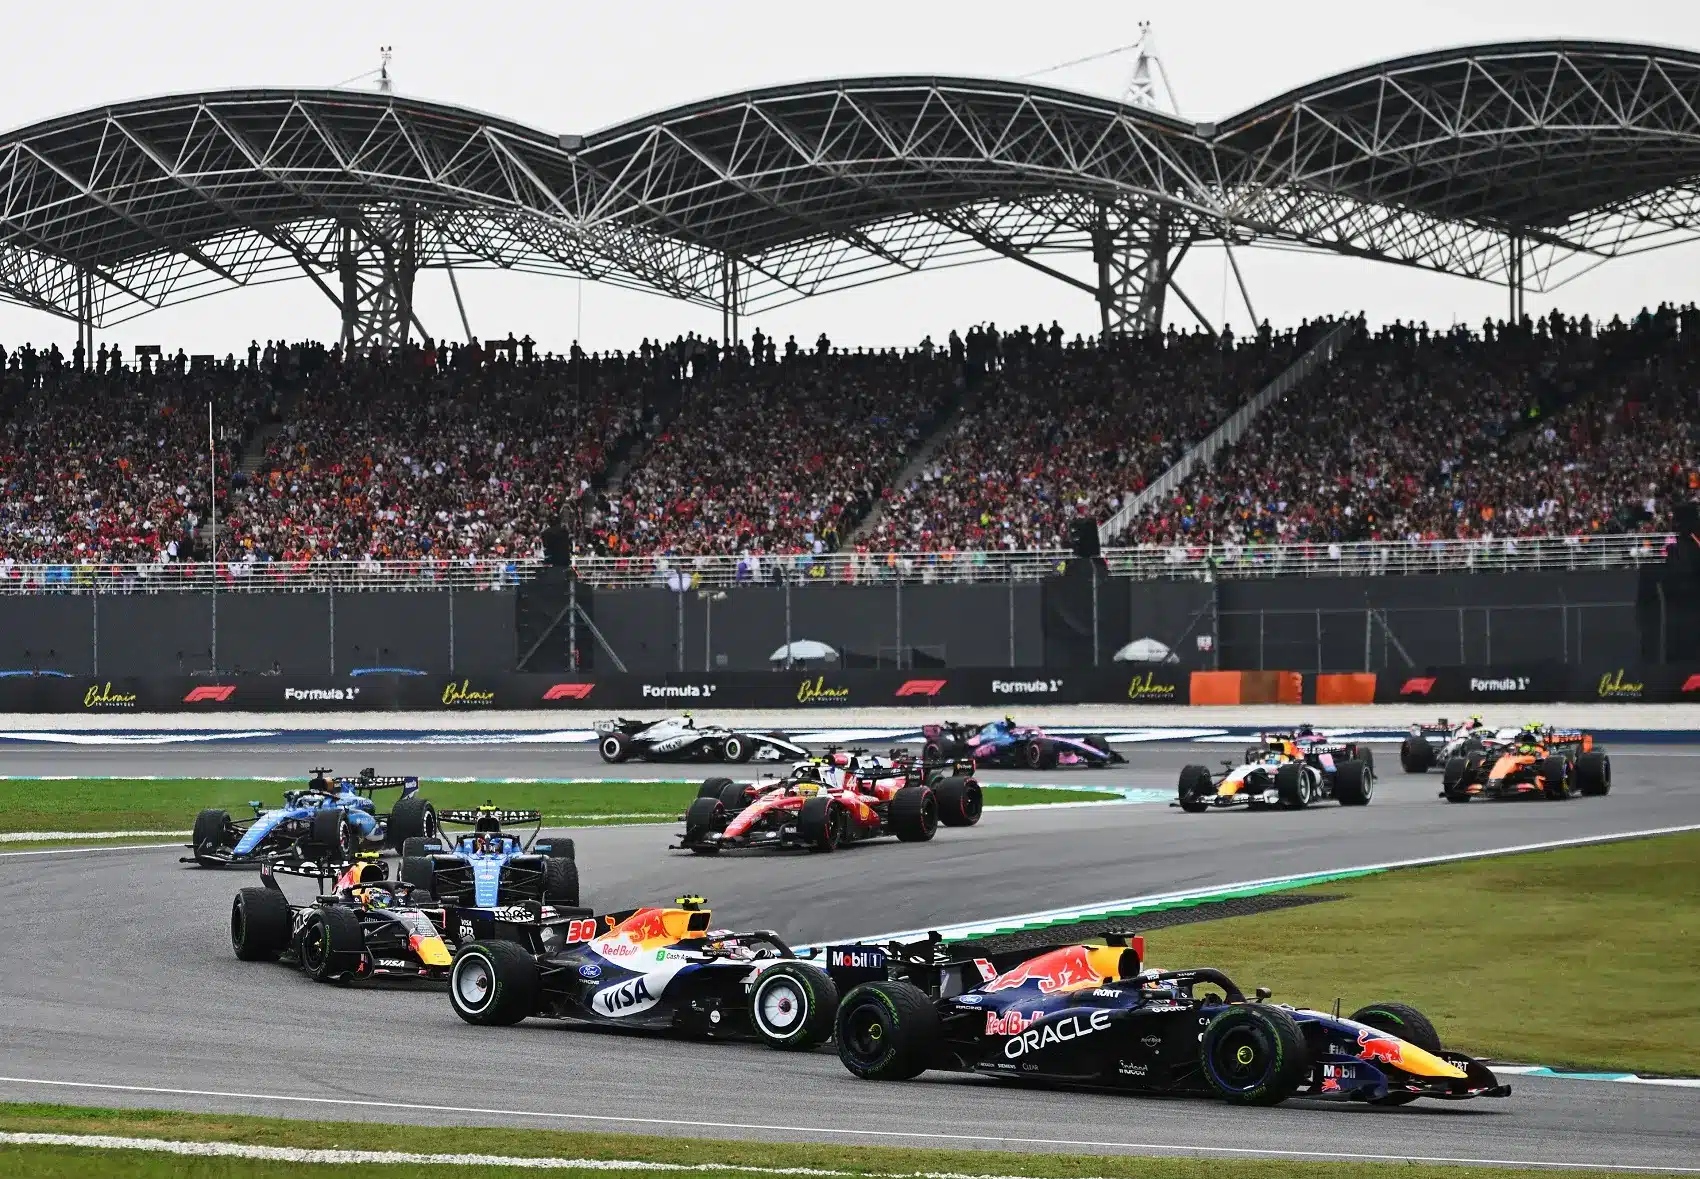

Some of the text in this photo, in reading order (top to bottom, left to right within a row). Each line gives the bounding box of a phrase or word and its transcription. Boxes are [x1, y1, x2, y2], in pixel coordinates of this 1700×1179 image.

[797, 676, 849, 701] Bahrain
[992, 680, 1048, 693] Formula
[1128, 671, 1176, 697] Bahrain
[1470, 677, 1517, 691] Formula
[1599, 668, 1644, 695] Bahrain
[84, 682, 136, 707] Bahrain
[285, 687, 345, 700] Formula
[442, 679, 495, 704] Bahrain
[642, 685, 700, 697] Formula
[341, 777, 405, 788] ATLSSIAN
[450, 810, 530, 821] ATLASIAN
[567, 919, 597, 943] 30
[602, 943, 638, 956] Red Bull
[665, 952, 679, 960] Cash
[378, 959, 405, 967] VISA
[832, 951, 868, 968] Mobil
[603, 977, 656, 1013] VISA
[1092, 988, 1123, 998] ROKT
[985, 1011, 1010, 1036] Red
[1004, 1011, 1112, 1059] ORACLE
[1323, 1064, 1356, 1079] Mobil
